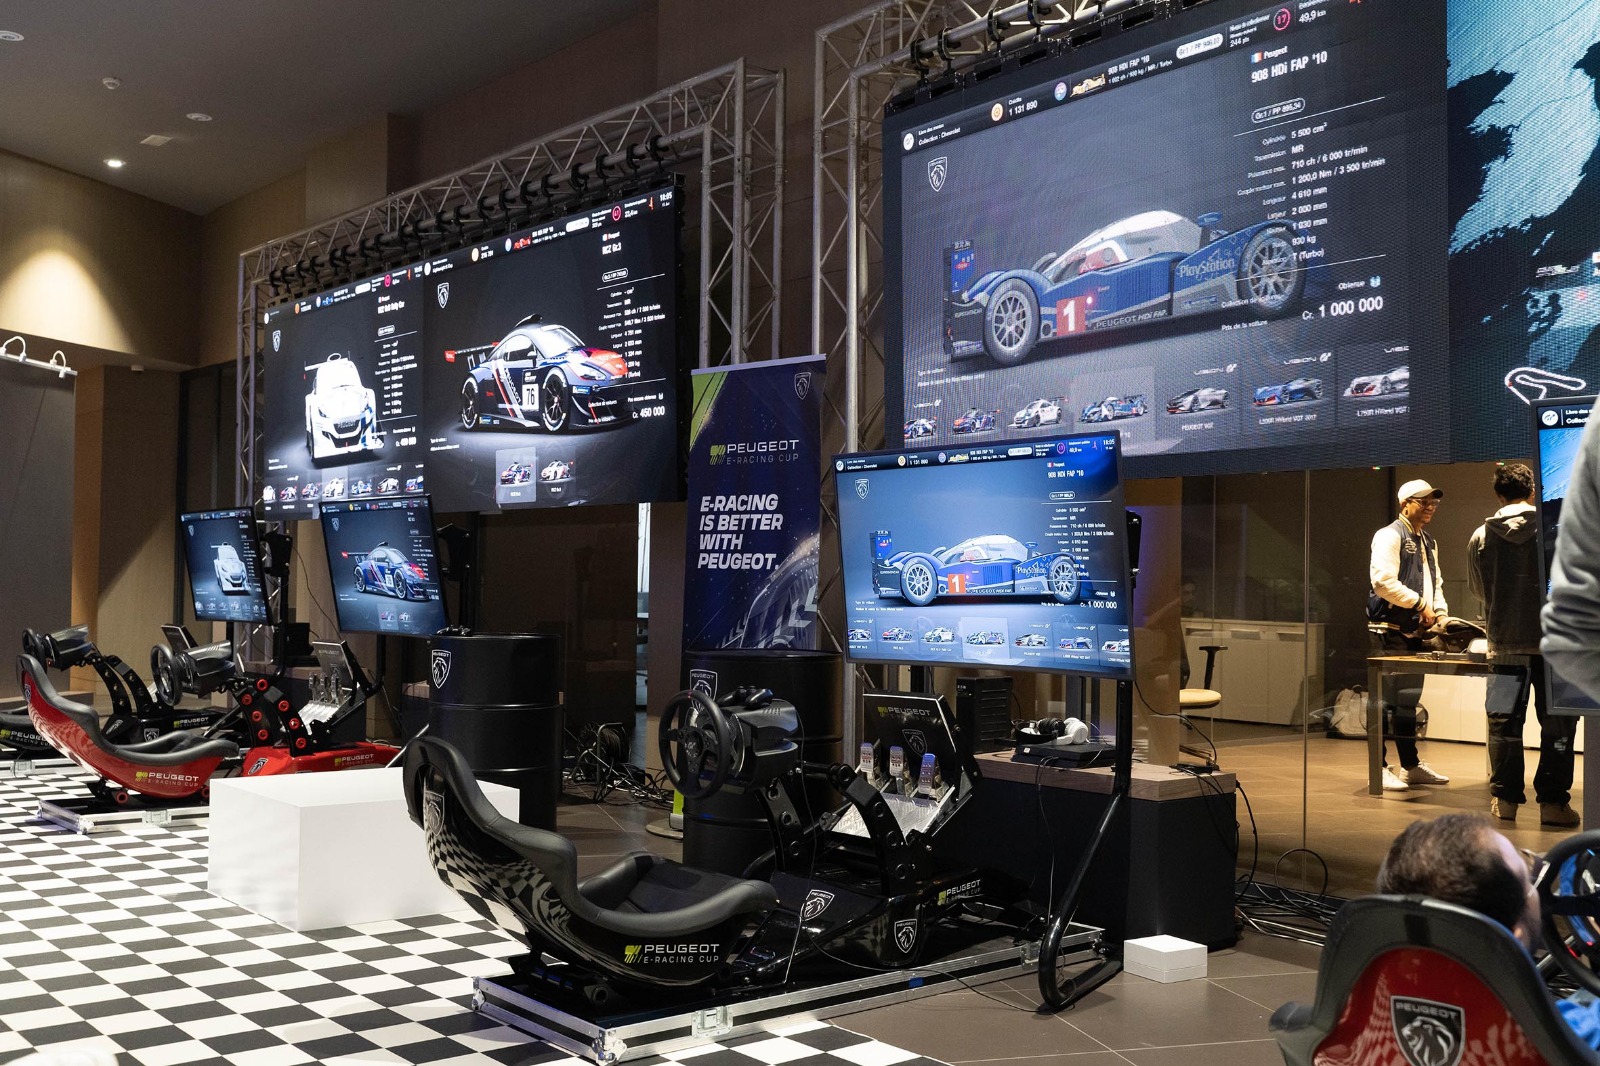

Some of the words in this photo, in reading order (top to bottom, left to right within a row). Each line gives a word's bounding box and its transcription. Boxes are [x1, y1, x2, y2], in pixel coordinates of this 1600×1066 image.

[1264, 46, 1288, 60] Peugeot
[1252, 68, 1269, 84] 908
[1271, 62, 1288, 78] HDi
[1291, 56, 1309, 72] FAP
[1312, 51, 1328, 65] '10
[1014, 106, 1025, 114] 131
[1026, 100, 1038, 111] 890
[1292, 144, 1304, 154] MR
[1292, 160, 1305, 170] 710
[1306, 157, 1316, 166] ch
[1329, 150, 1344, 161] 000
[1298, 172, 1318, 186] 200,0
[1346, 162, 1360, 172] 500
[1298, 248, 1325, 262] (Turbo)
[1180, 258, 1235, 278] PlayStation
[1318, 304, 1326, 318] 1
[1330, 300, 1355, 317] 000
[1358, 296, 1384, 314] 000
[1062, 300, 1076, 332] 1
[1096, 316, 1137, 329] PEUGEOT
[526, 388, 535, 406] 76
[727, 440, 800, 454] PEUGEOT
[726, 454, 774, 465] E-RACING
[778, 454, 799, 462] CUP
[700, 494, 778, 512] E-RACING
[699, 514, 714, 531] IS
[717, 514, 784, 531] BETTER
[699, 533, 744, 550] WITH
[698, 552, 779, 570] PEUGEOT.
[951, 575, 960, 592] 1
[1106, 602, 1118, 610] 000
[888, 706, 930, 716] PEUGEOT
[342, 754, 374, 762] PEUGEOT
[148, 772, 199, 782] PEUGEOT
[946, 879, 980, 896] PEUGEOT
[644, 944, 720, 954] PEUGEOT
[644, 956, 694, 964] E-RACING
[1395, 1002, 1458, 1020] PEUGEOT
